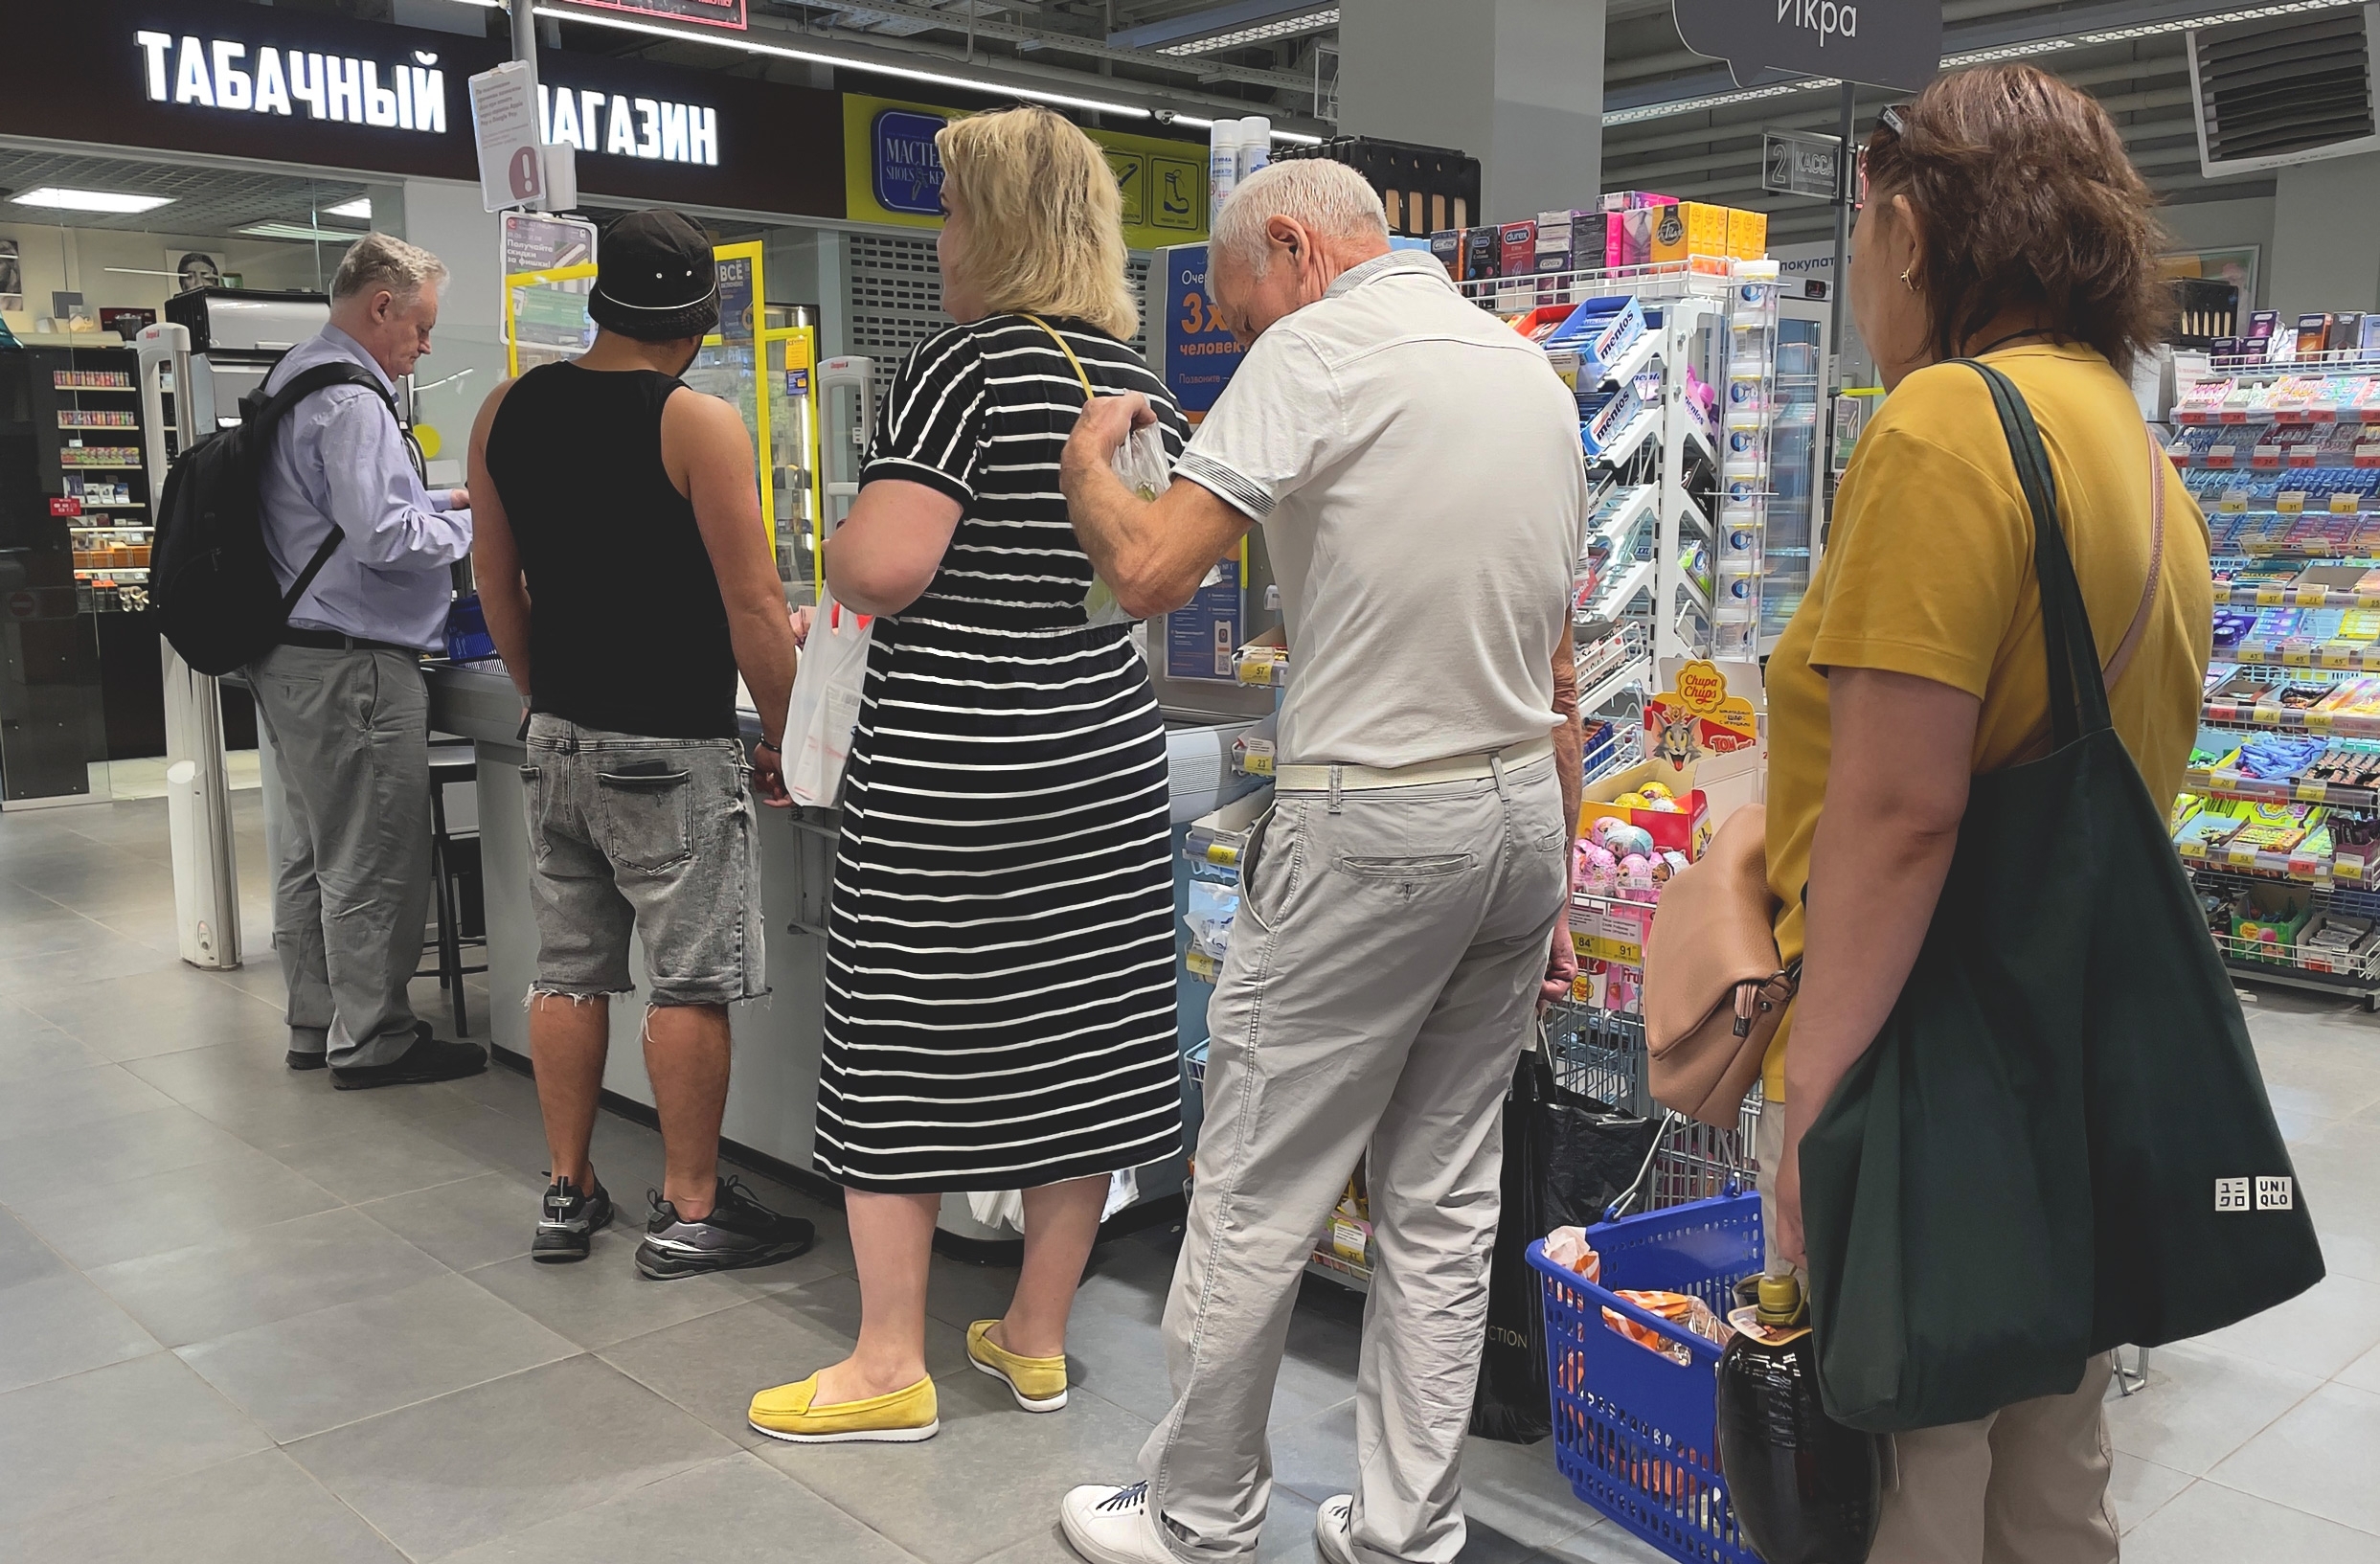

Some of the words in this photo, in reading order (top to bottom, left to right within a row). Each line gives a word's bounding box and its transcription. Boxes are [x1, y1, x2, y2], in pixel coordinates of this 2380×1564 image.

[134, 30, 447, 133] ТАБАЧНЫЙ
[886, 137, 943, 168] МАСТЕ
[1771, 144, 1787, 184] 2
[1795, 150, 1836, 177] КАССА
[886, 165, 915, 182] SHOES
[1506, 232, 1528, 241] durex
[507, 238, 554, 252] Получайте
[507, 249, 536, 258] скидки
[719, 260, 744, 283] ВСЁ
[1598, 309, 1634, 361] mentos
[1178, 373, 1221, 384] Позвоните
[1595, 390, 1630, 442] mentos
[1256, 667, 1265, 675] 57
[1685, 674, 1718, 688] Chupa
[1684, 686, 1717, 704] Chups
[1258, 759, 1267, 767] 23
[1577, 937, 1591, 947] 84
[1620, 944, 1632, 956] 91
[2259, 1180, 2285, 1192] UNI
[2260, 1193, 2288, 1207] QLO
